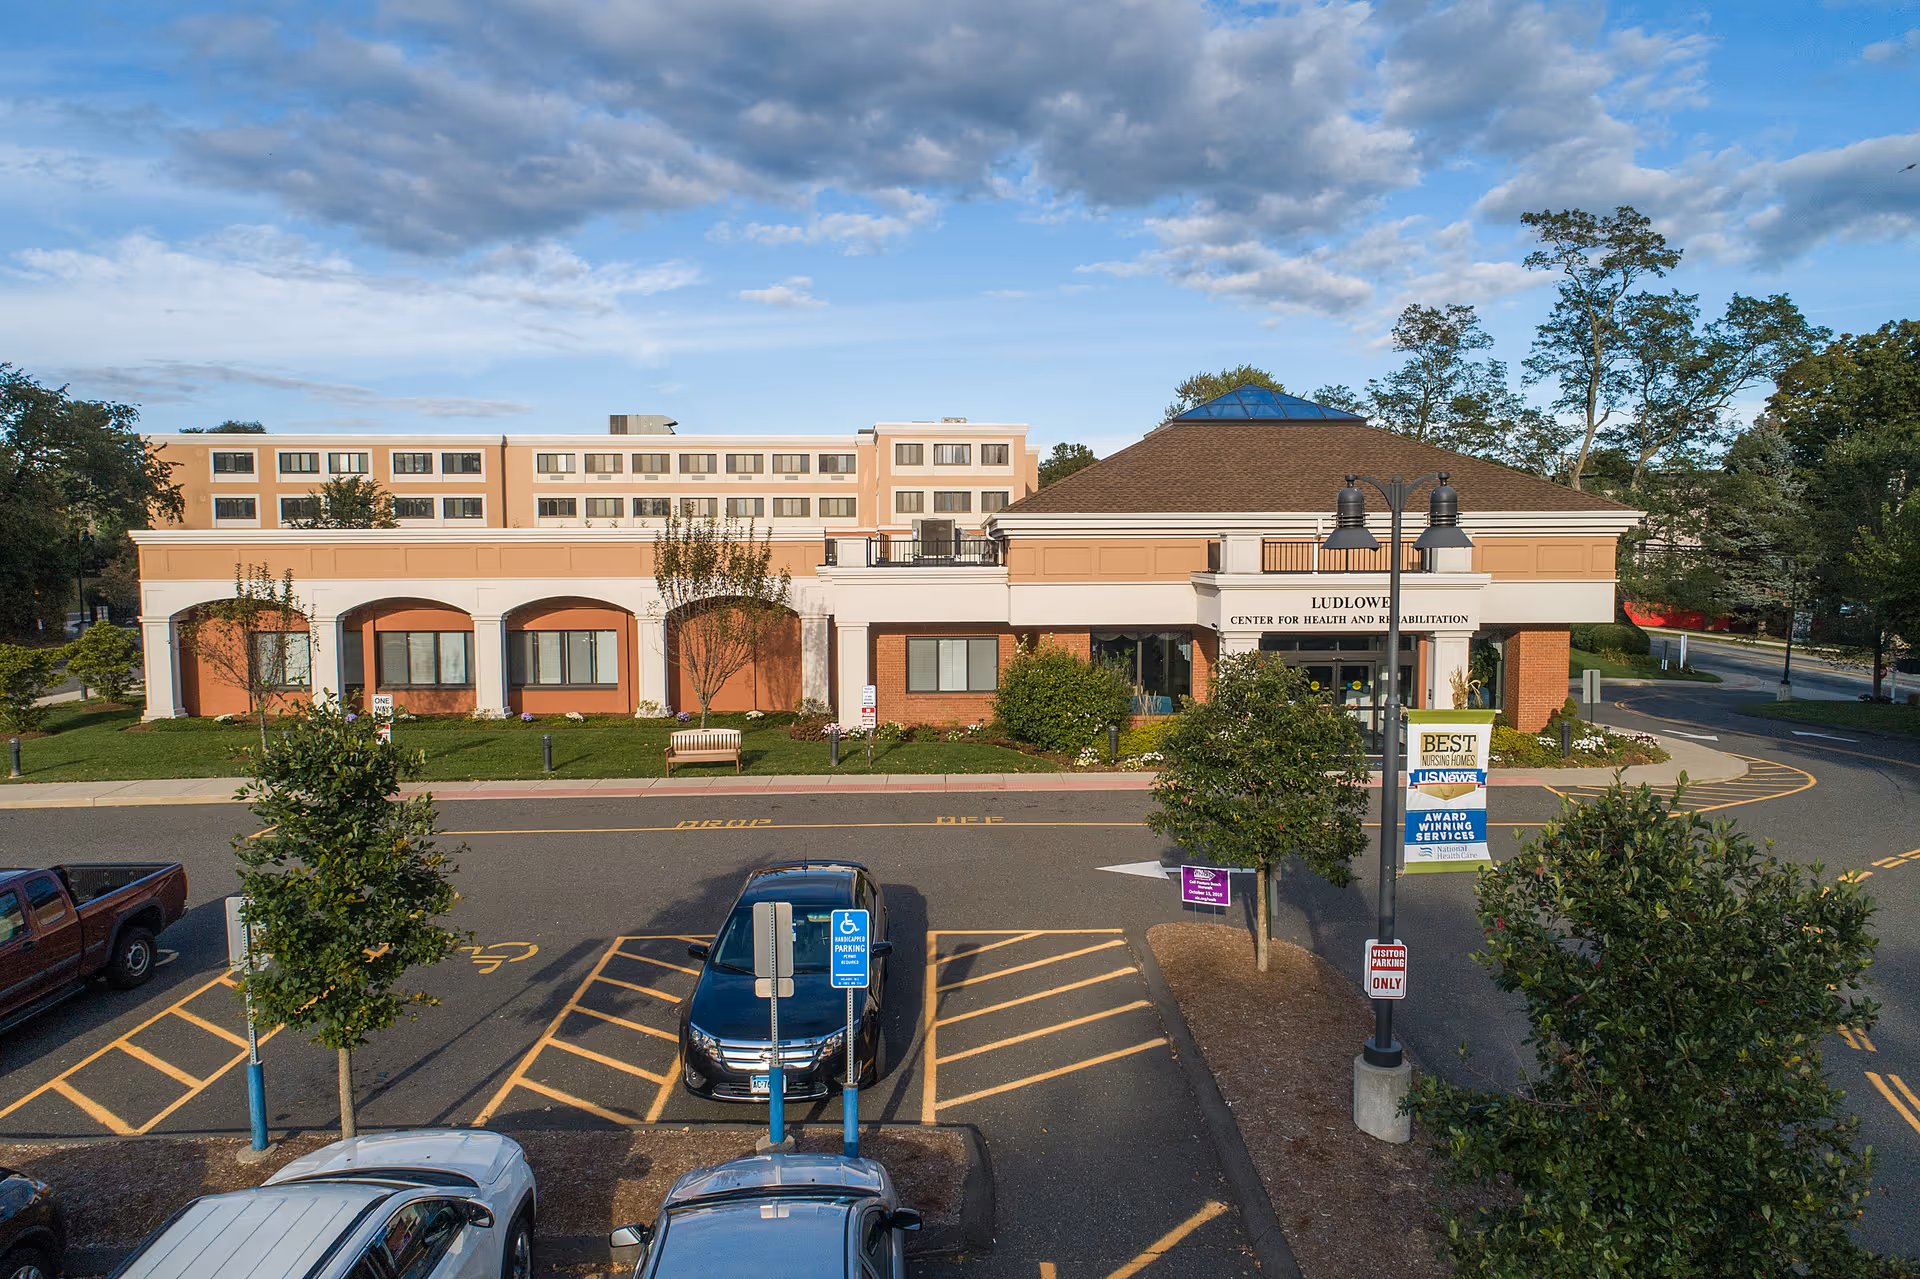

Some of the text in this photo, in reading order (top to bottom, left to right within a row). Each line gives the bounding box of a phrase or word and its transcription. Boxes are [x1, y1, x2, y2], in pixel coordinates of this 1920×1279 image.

[1230, 614, 1469, 625] CENTER FOR HEALTH AND REABILITATION
[1422, 734, 1477, 753] BEST
[1422, 754, 1475, 767] NURSING HOMES
[1424, 812, 1467, 822] AWARD
[1418, 821, 1472, 831] WINNING
[1415, 831, 1475, 841] SERVICES
[1437, 845, 1467, 853] National
[1372, 959, 1404, 967] PARKING
[1373, 977, 1401, 989] ONLY
